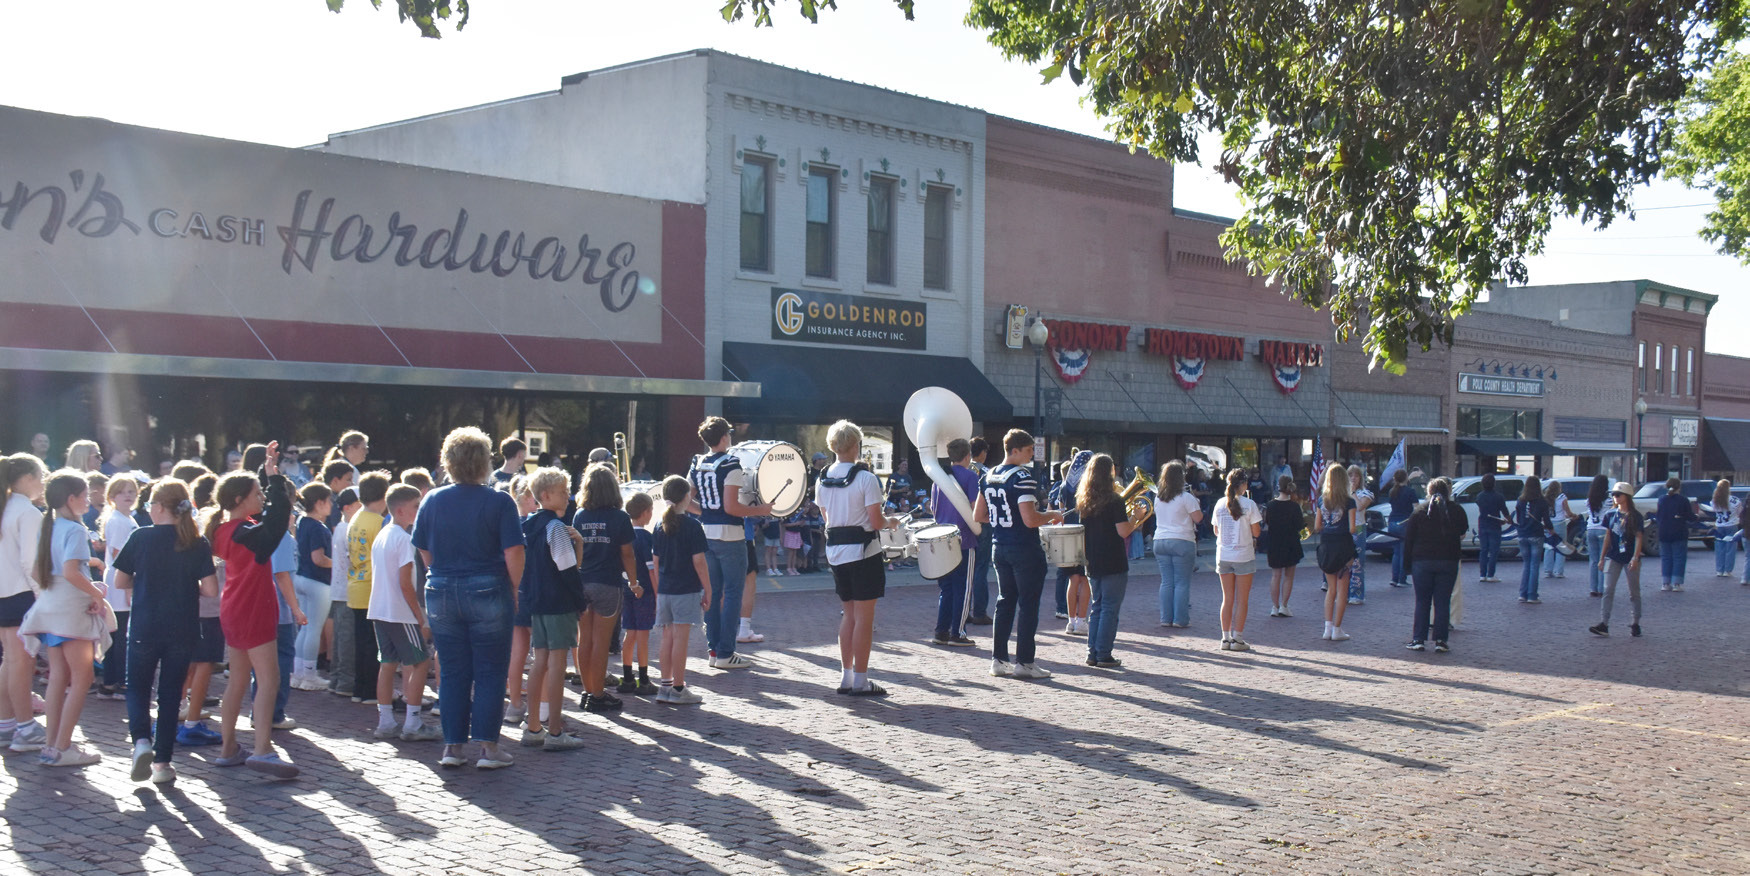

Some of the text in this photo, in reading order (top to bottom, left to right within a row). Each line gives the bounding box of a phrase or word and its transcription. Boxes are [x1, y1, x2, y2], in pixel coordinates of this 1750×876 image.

[0, 168, 142, 245] n's
[147, 207, 265, 247] CASH
[808, 301, 925, 328] GOLDENROD
[808, 325, 907, 342] INSURANCE AGENCY INC.
[1041, 319, 1131, 352] CONOMY
[1146, 328, 1245, 362] HOMETOWN
[1260, 339, 1325, 368] MARKET
[1484, 379, 1500, 392] COUNTY
[1501, 380, 1516, 392] HEALTH
[1516, 381, 1540, 394] DEPARTMENT
[774, 453, 795, 461] YAMAHA
[696, 471, 721, 510] 10
[984, 487, 1013, 528] 63
[581, 522, 606, 530] MINDSET
